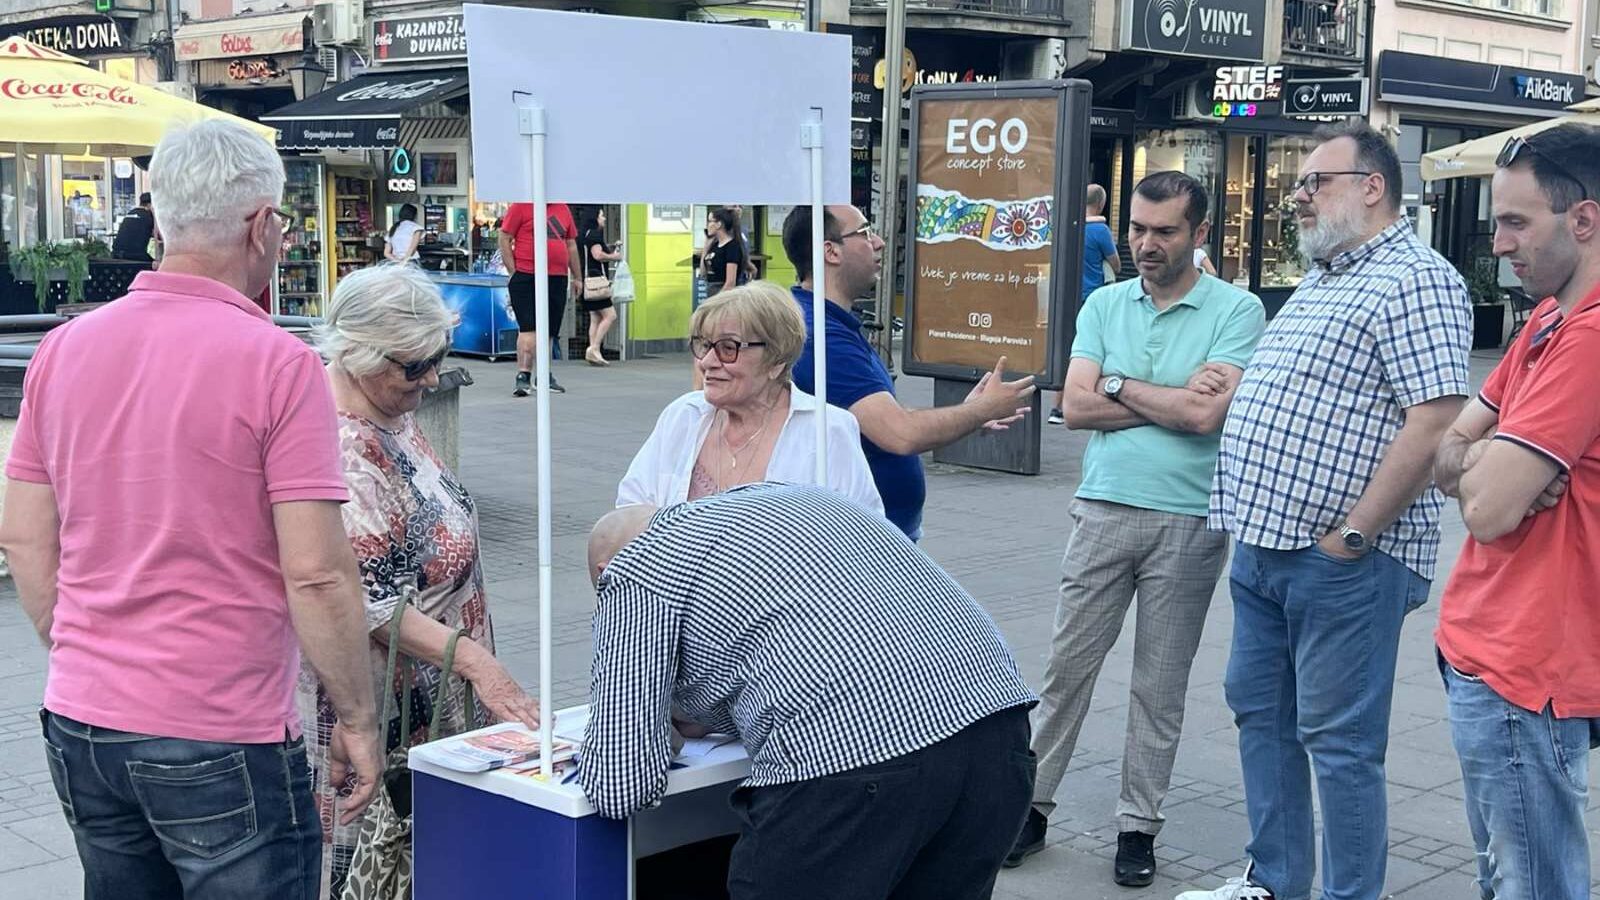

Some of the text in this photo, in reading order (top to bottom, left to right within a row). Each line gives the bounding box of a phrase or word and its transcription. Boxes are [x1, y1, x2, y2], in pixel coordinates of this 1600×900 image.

[395, 17, 466, 39] KAZANDŽIJ
[1200, 7, 1253, 37] VINYL
[76, 23, 122, 50] DONA
[409, 33, 466, 54] DUVANČE
[1200, 34, 1229, 46] CAFE
[1215, 65, 1284, 84] STEF
[1, 78, 138, 105] Coca-Cola
[1212, 84, 1266, 101] ANO
[1321, 93, 1354, 103] VINYL
[1524, 76, 1574, 103] AikBank
[946, 117, 1029, 155] EGO
[946, 154, 1026, 177] concept store
[388, 179, 416, 192] IQOS
[920, 266, 945, 279] Uvek
[944, 268, 959, 287] je
[961, 270, 992, 281] vreme
[994, 273, 1005, 283] za
[1008, 270, 1021, 289] lep
[928, 329, 946, 338] Planet
[946, 331, 977, 341] Residence
